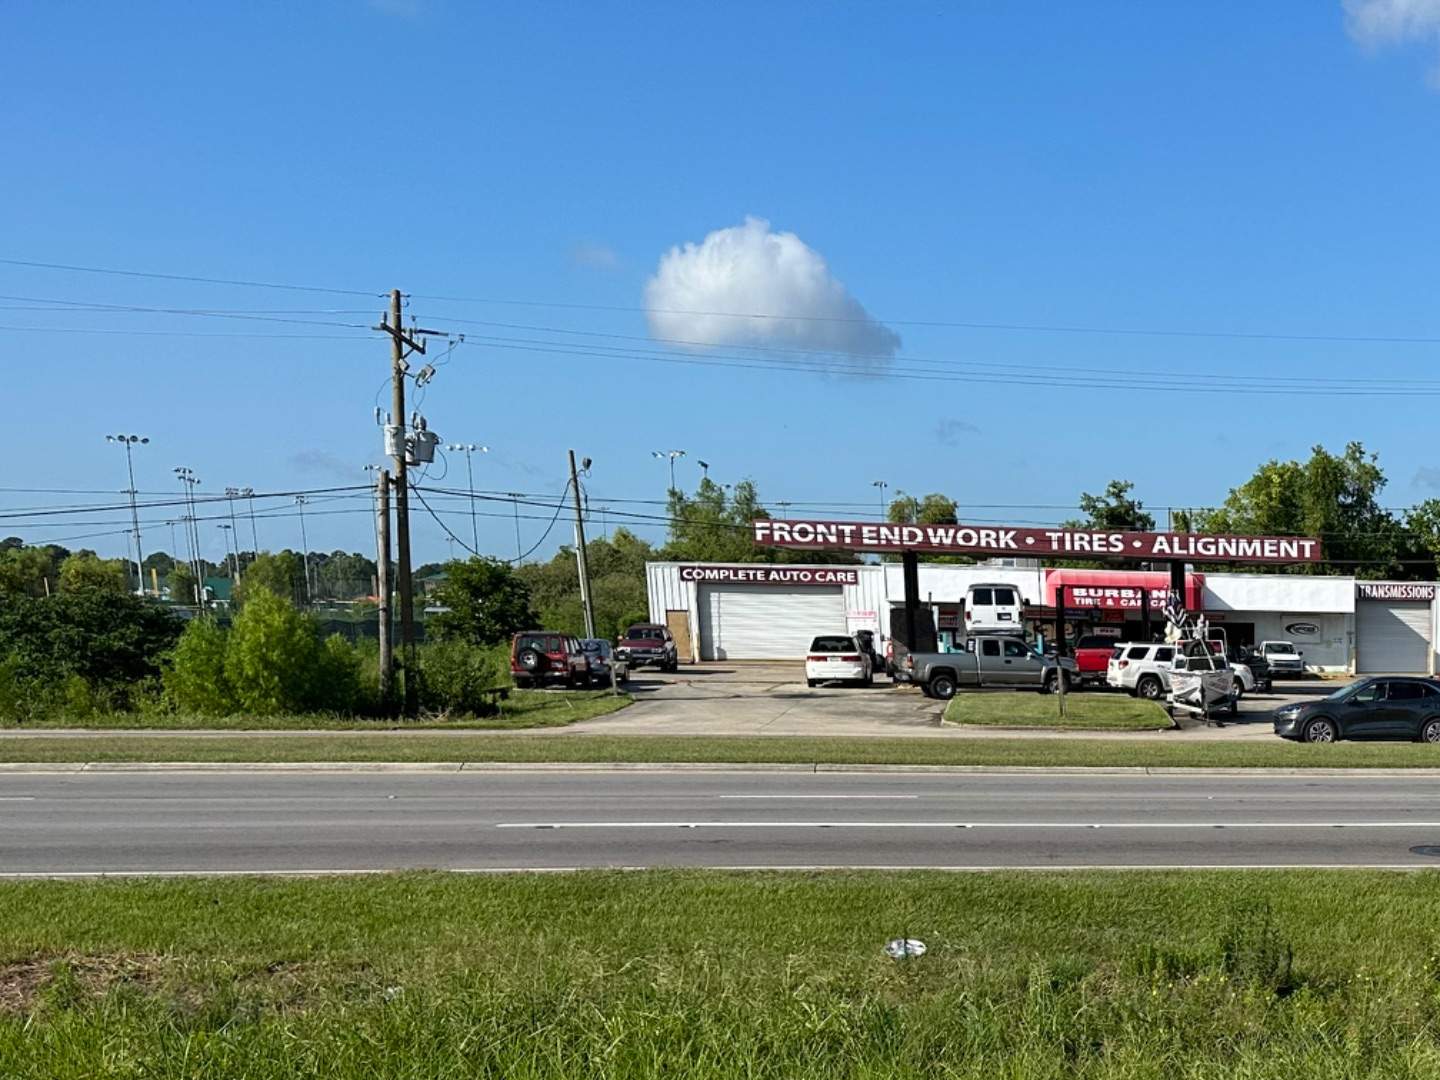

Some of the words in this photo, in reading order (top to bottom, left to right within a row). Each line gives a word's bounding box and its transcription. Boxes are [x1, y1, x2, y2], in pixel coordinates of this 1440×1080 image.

[755, 522, 857, 544] FRONT
[862, 526, 923, 545] END
[927, 529, 1019, 549] WORK
[1046, 532, 1123, 551] TIRES
[1152, 536, 1316, 558] ALIGNMENT
[682, 569, 766, 581] COMPLETE
[769, 570, 812, 581] AUTO
[815, 571, 857, 582] CARE
[1360, 584, 1434, 598] TRANSMISSIONS
